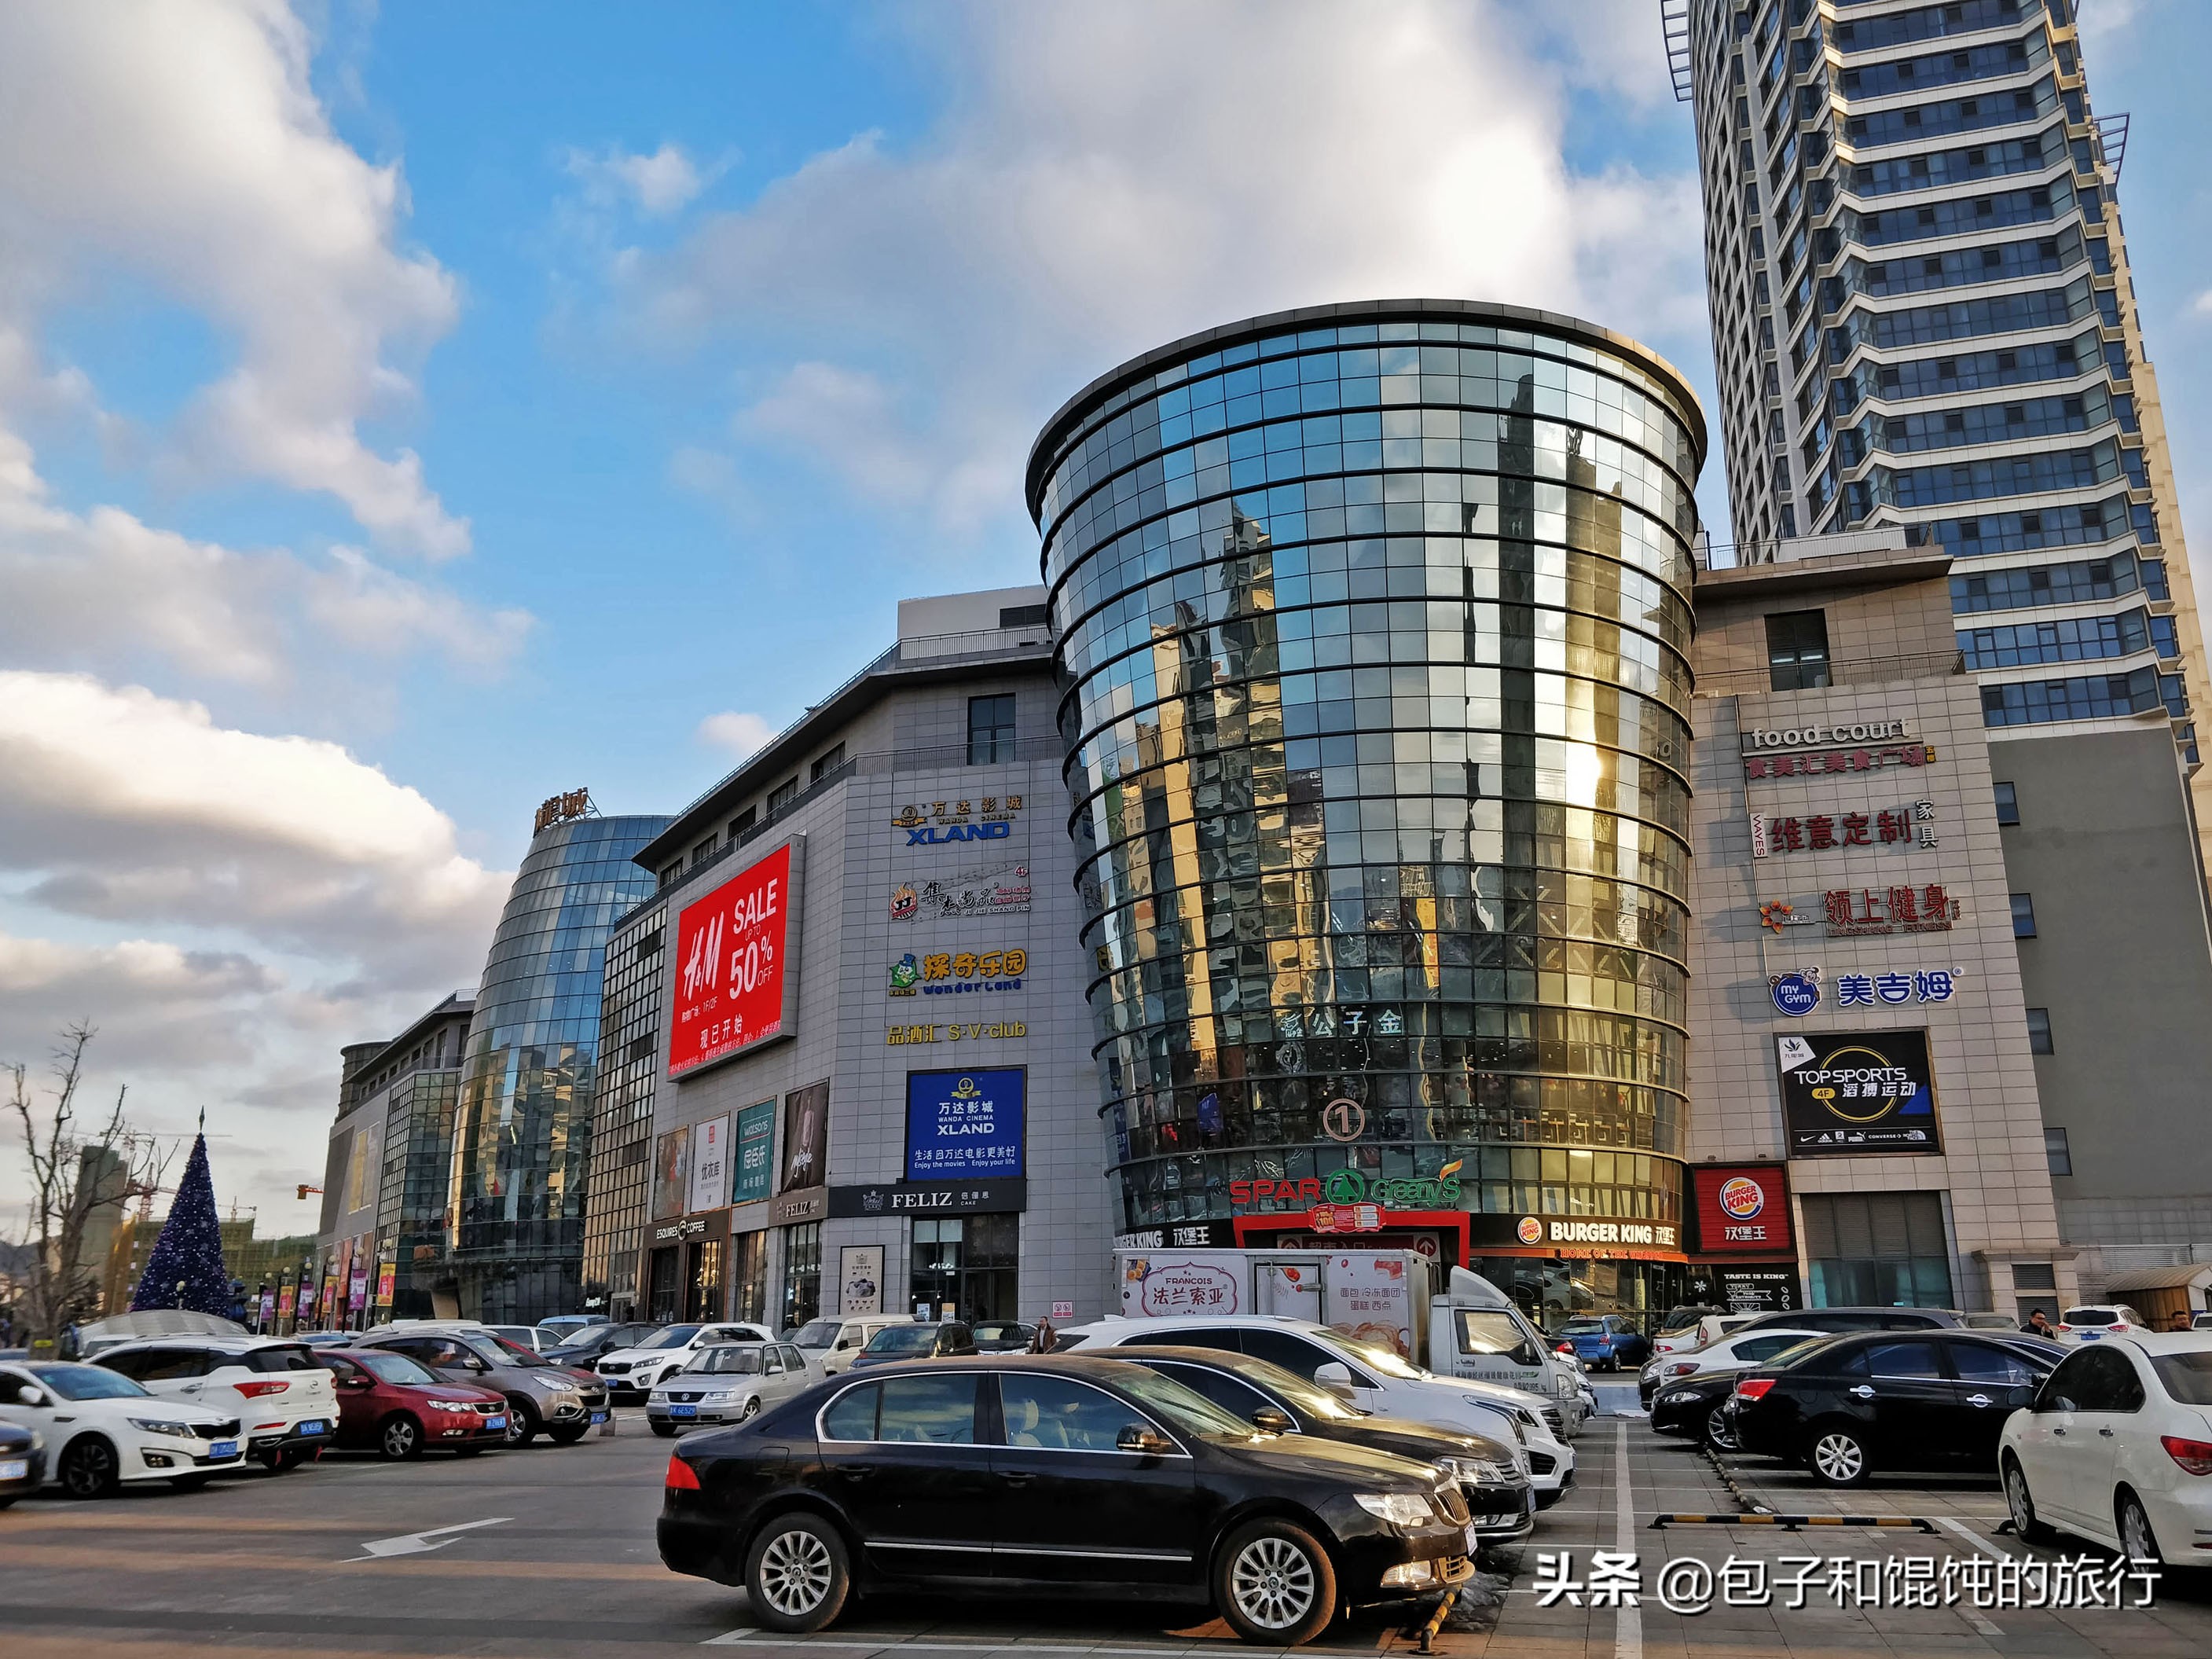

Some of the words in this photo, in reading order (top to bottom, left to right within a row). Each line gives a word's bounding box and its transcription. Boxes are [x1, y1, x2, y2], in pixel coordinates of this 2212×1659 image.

[1752, 723, 1821, 748] food
[1832, 718, 1910, 743] court
[1746, 746, 1924, 779] 食美汇美食广场
[931, 795, 1022, 817] 万达影城
[981, 813, 1016, 821] CINEMA
[1915, 798, 1939, 849] 家具
[906, 822, 1010, 846] XLAND
[1772, 809, 1912, 853] 维意定制
[1014, 865, 1028, 876] 4F
[733, 878, 778, 934] SALE
[1825, 884, 1949, 926] 领上健身
[684, 911, 724, 1000] H&M
[923, 949, 1026, 981] 探奇乐园
[758, 965, 772, 986] OFF
[1837, 970, 1954, 1006] 美吉姆
[699, 1013, 743, 1050] 现已开始
[886, 1024, 941, 1045] 品酒汇
[1794, 1067, 1907, 1085] TOPSPORTS
[1818, 1089, 1830, 1098] 4F
[1842, 1081, 1917, 1098] 滔搏运动
[938, 1100, 994, 1115] 万达影城
[937, 1122, 995, 1136] XLAND
[891, 1192, 952, 1209] FELIZ
[1231, 1178, 1321, 1204] SPAR
[1726, 1186, 1756, 1200] BURGER
[1727, 1192, 1759, 1210] KING
[786, 1202, 809, 1217] FELIZ
[687, 1220, 706, 1234] COFFEE
[1136, 1230, 1163, 1248] KING
[1173, 1226, 1210, 1246] 汉堡王
[1521, 1223, 1538, 1232] BURGER
[1522, 1228, 1539, 1236] KING
[1550, 1222, 1618, 1242] BURGER
[1621, 1224, 1652, 1244] KING
[1656, 1226, 1675, 1245] 汉堡王
[1725, 1226, 1766, 1240] 汉堡王
[1153, 1286, 1225, 1306] 法兰索亚
[1341, 1287, 1359, 1297] 面包
[1362, 1287, 1400, 1297] 冷冻面团
[1350, 1301, 1370, 1311] 蛋糕
[1372, 1301, 1391, 1311] 西点
